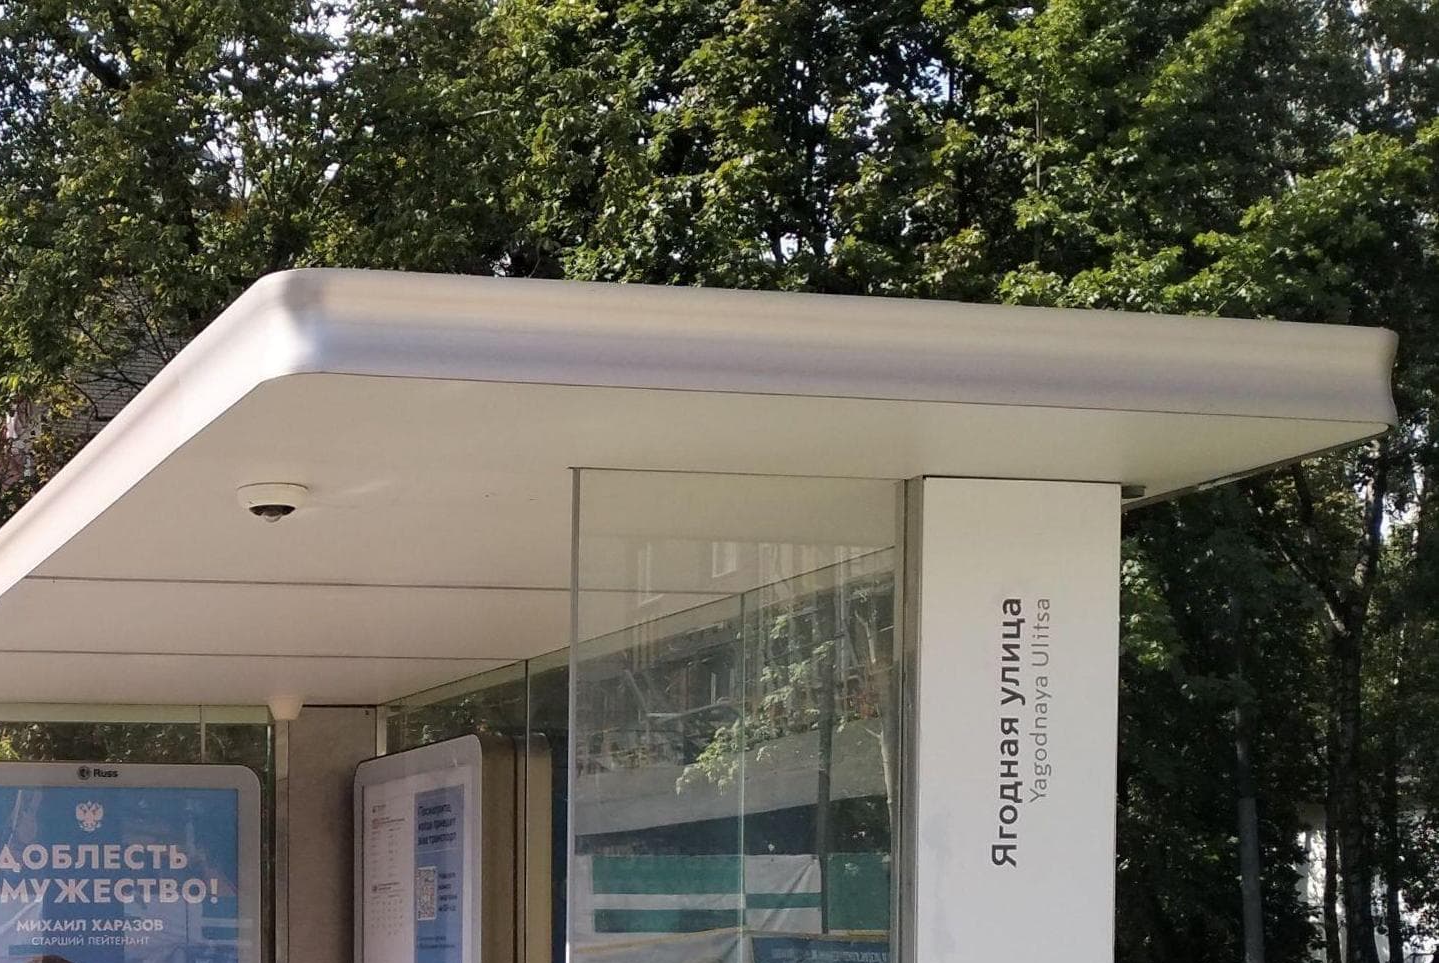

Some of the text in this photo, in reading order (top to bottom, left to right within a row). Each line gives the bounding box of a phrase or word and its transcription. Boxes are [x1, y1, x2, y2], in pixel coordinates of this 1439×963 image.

[1029, 598, 1052, 803] Yagodnaya Ulitsa
[991, 597, 1026, 868] Ягодная улица
[93, 767, 119, 778] Russ
[0, 877, 219, 905] МУЖЕСТВО!
[16, 919, 164, 932] МИХАИЛ ХАРАЗОВ
[31, 935, 84, 946] СТАРШИЙ
